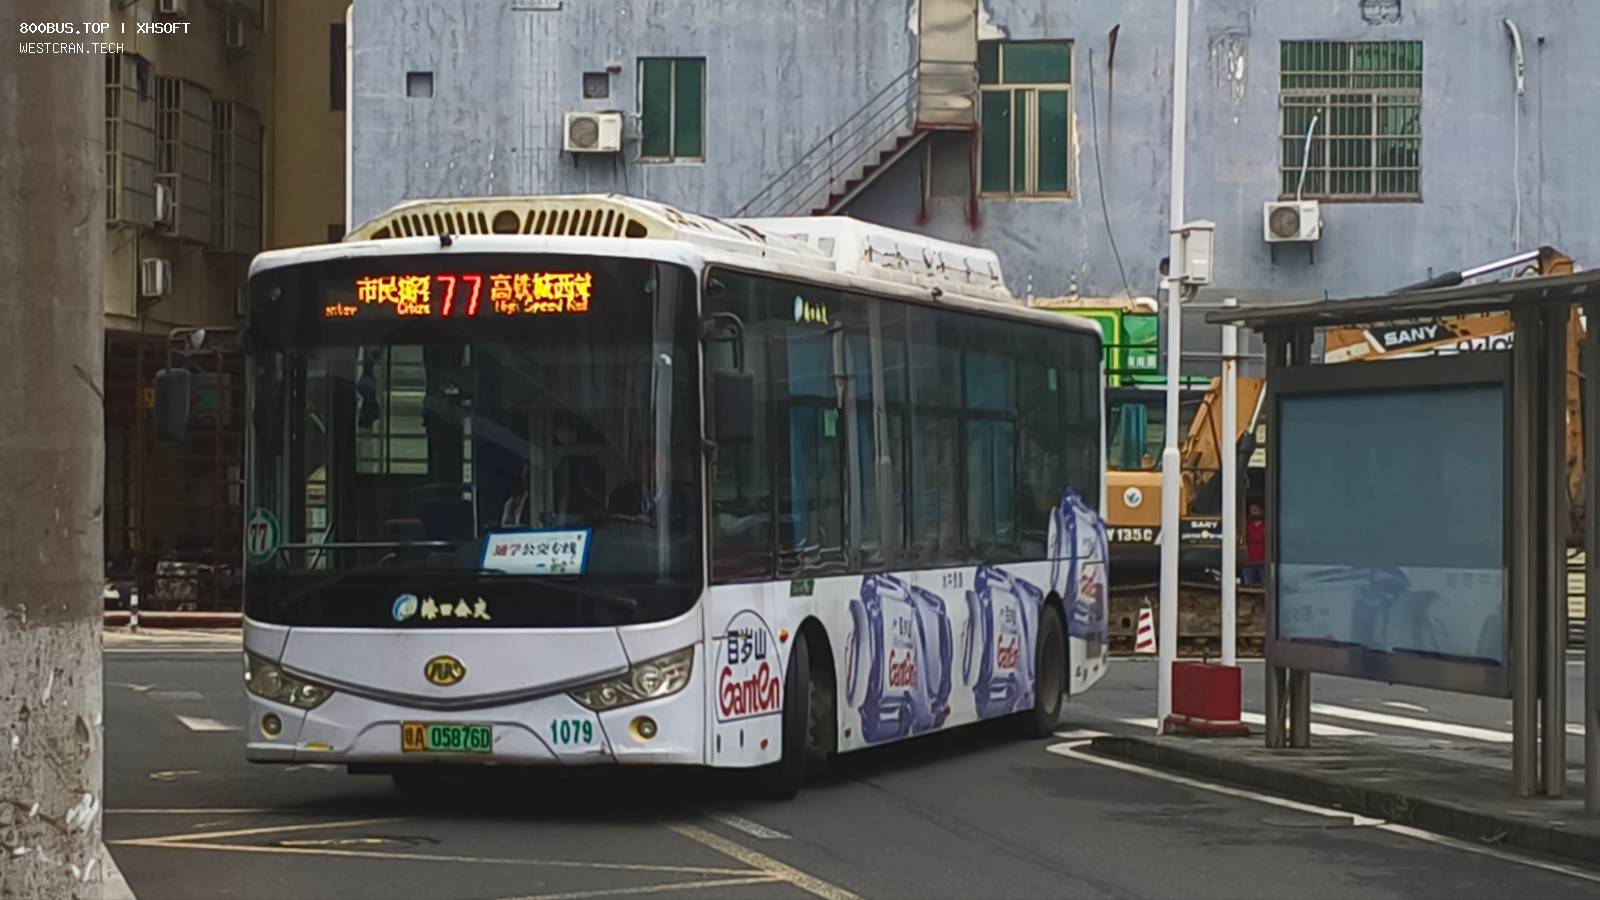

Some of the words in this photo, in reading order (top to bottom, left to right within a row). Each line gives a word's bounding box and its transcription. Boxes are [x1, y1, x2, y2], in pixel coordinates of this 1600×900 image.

[436, 275, 482, 316] 77
[1384, 325, 1438, 346] SANY
[250, 523, 268, 552] 77
[431, 727, 490, 749] 05876D
[551, 719, 593, 745] 1079
